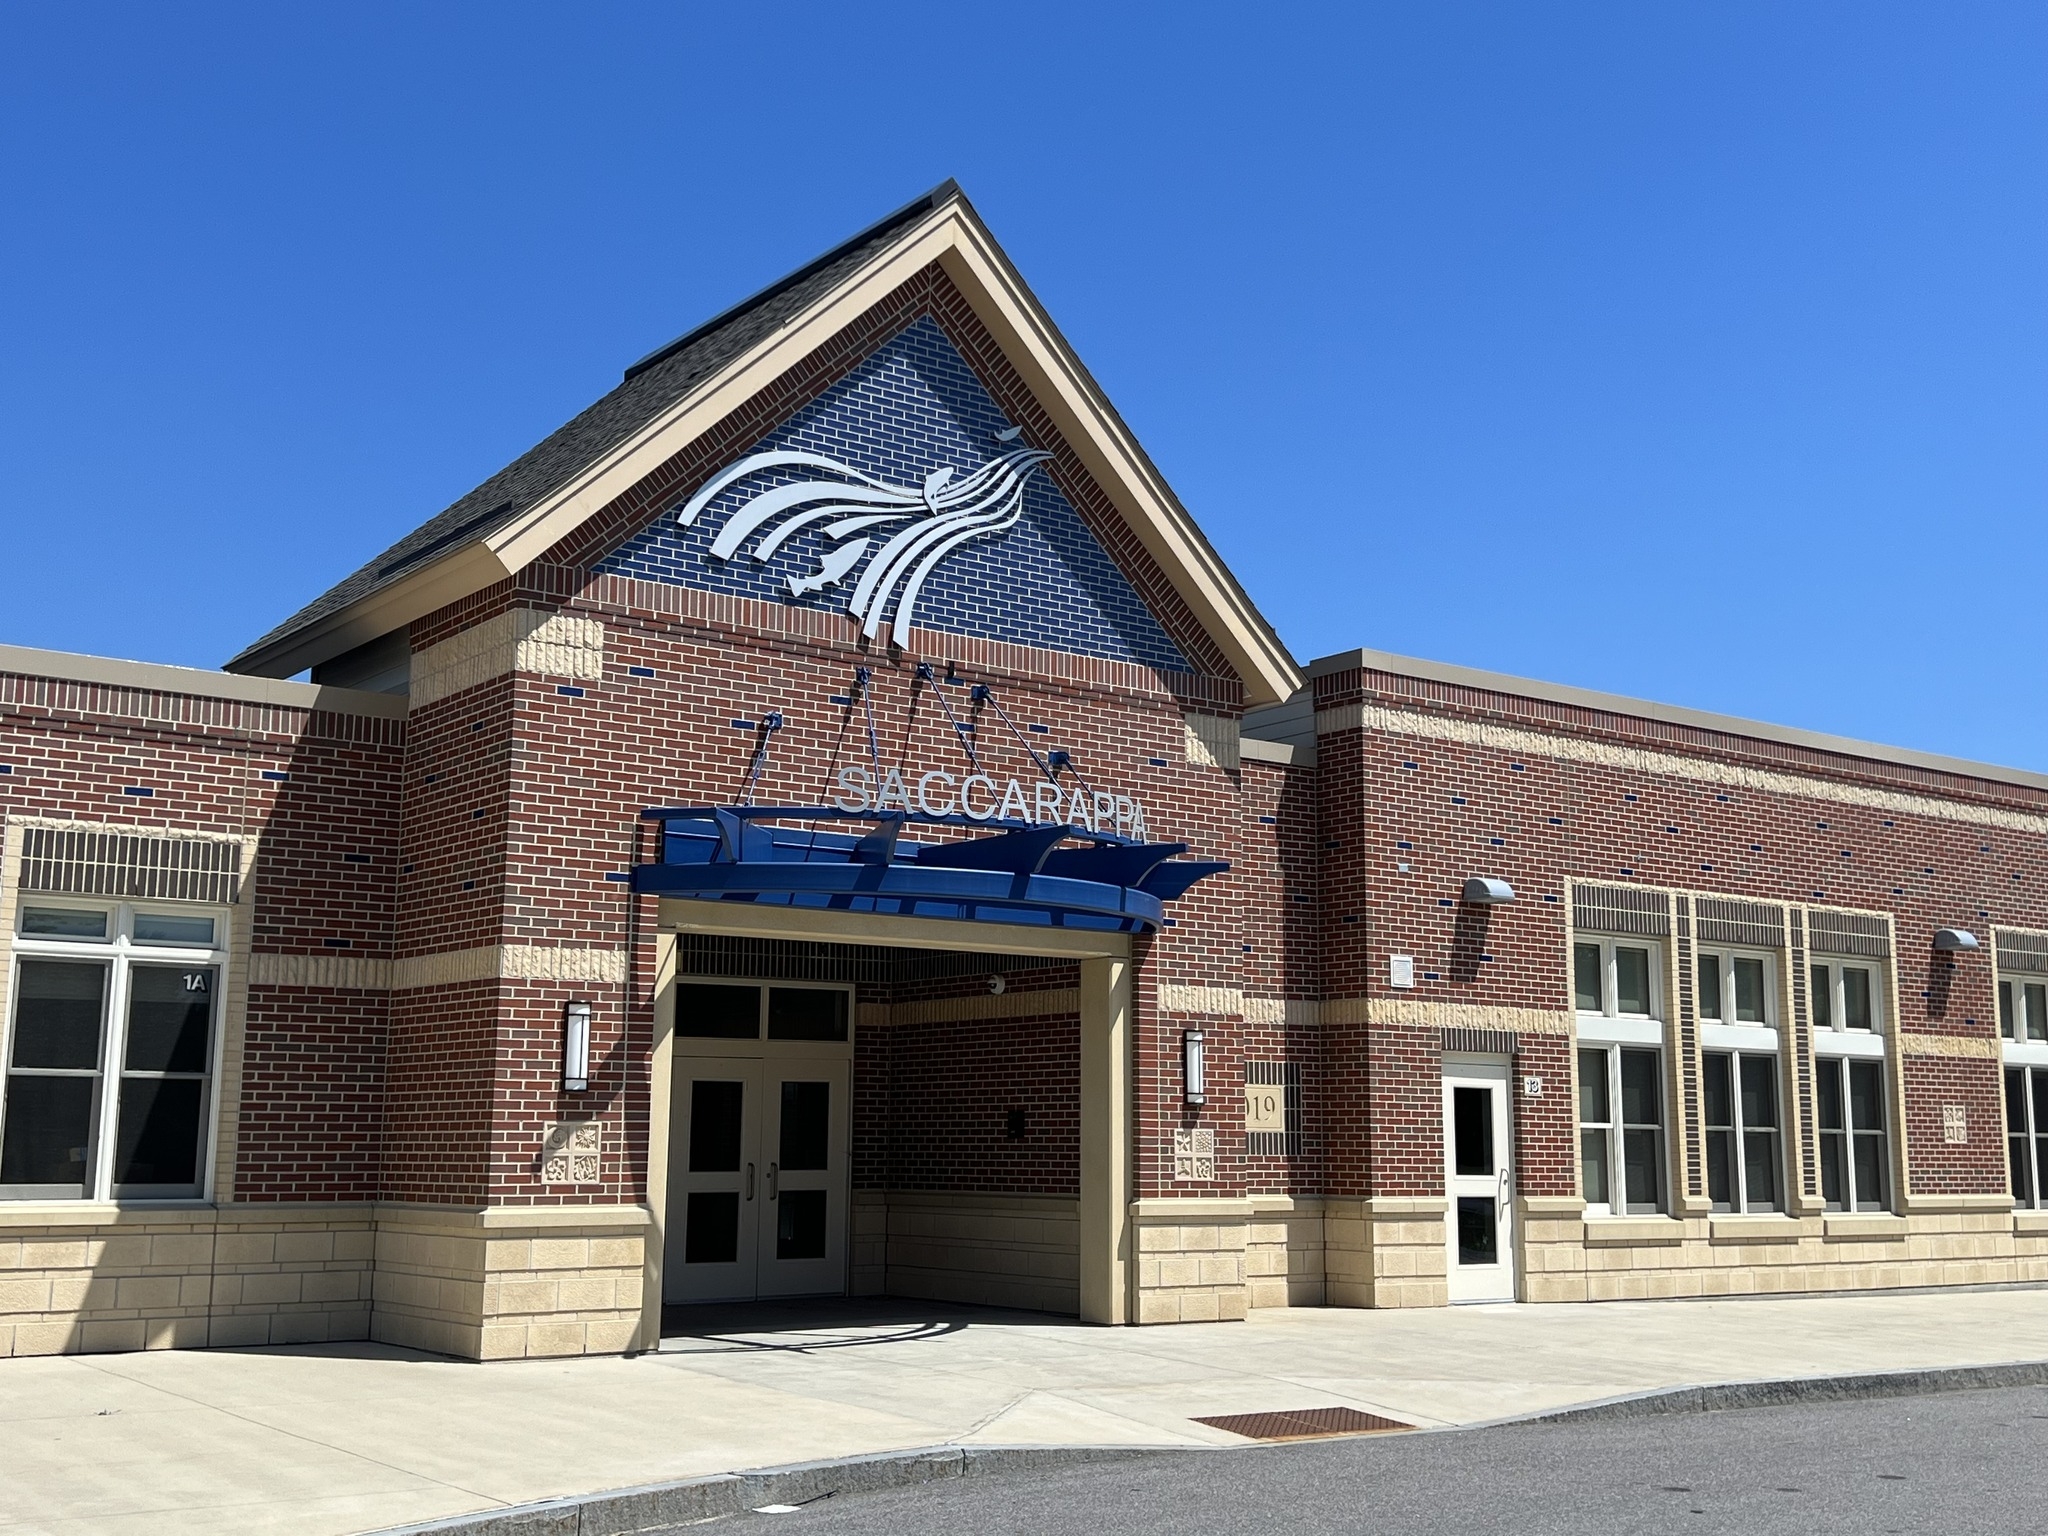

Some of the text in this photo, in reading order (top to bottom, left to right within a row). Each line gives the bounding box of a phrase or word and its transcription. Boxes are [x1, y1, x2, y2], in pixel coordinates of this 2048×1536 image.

[834, 766, 1147, 845] SACCARAPPA
[183, 974, 206, 990] 1A
[1526, 1078, 1540, 1093] 13
